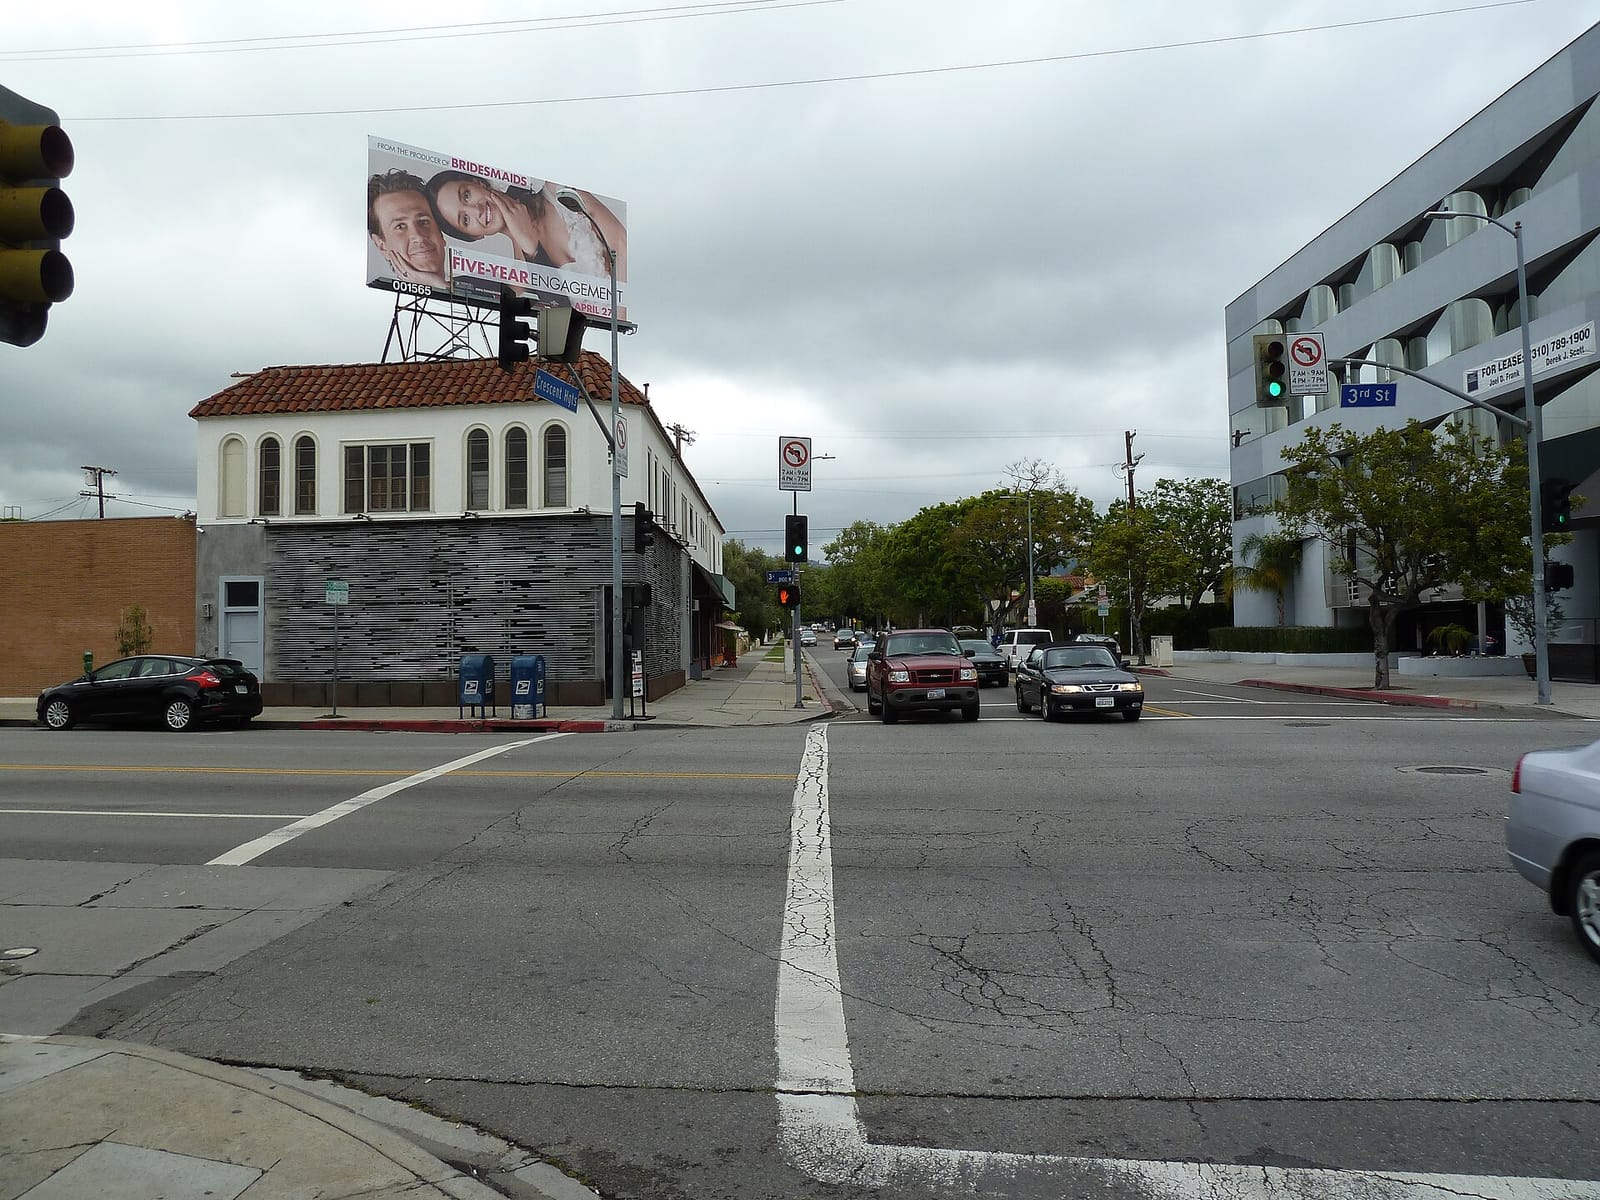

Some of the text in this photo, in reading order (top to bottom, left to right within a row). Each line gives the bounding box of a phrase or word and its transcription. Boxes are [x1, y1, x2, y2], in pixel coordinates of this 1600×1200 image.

[377, 142, 396, 153] FROM
[397, 147, 409, 156] THE
[409, 150, 442, 165] PRODUCER
[451, 157, 528, 187] BRIDESMAIDS
[453, 249, 463, 257] THE
[392, 280, 432, 296] 001565
[452, 256, 624, 303] FIVE-YEAR ENGAGEMENT
[574, 302, 613, 317] APRIL 27
[1481, 363, 1497, 378] FOR
[1550, 328, 1591, 352] 789-1900
[1545, 353, 1562, 366] Derek
[1569, 345, 1585, 358] Scott
[1489, 376, 1500, 387] Joel
[1505, 369, 1520, 381] Frank
[536, 375, 578, 408] Crescent Hgts
[1347, 388, 1390, 404] 3rd St
